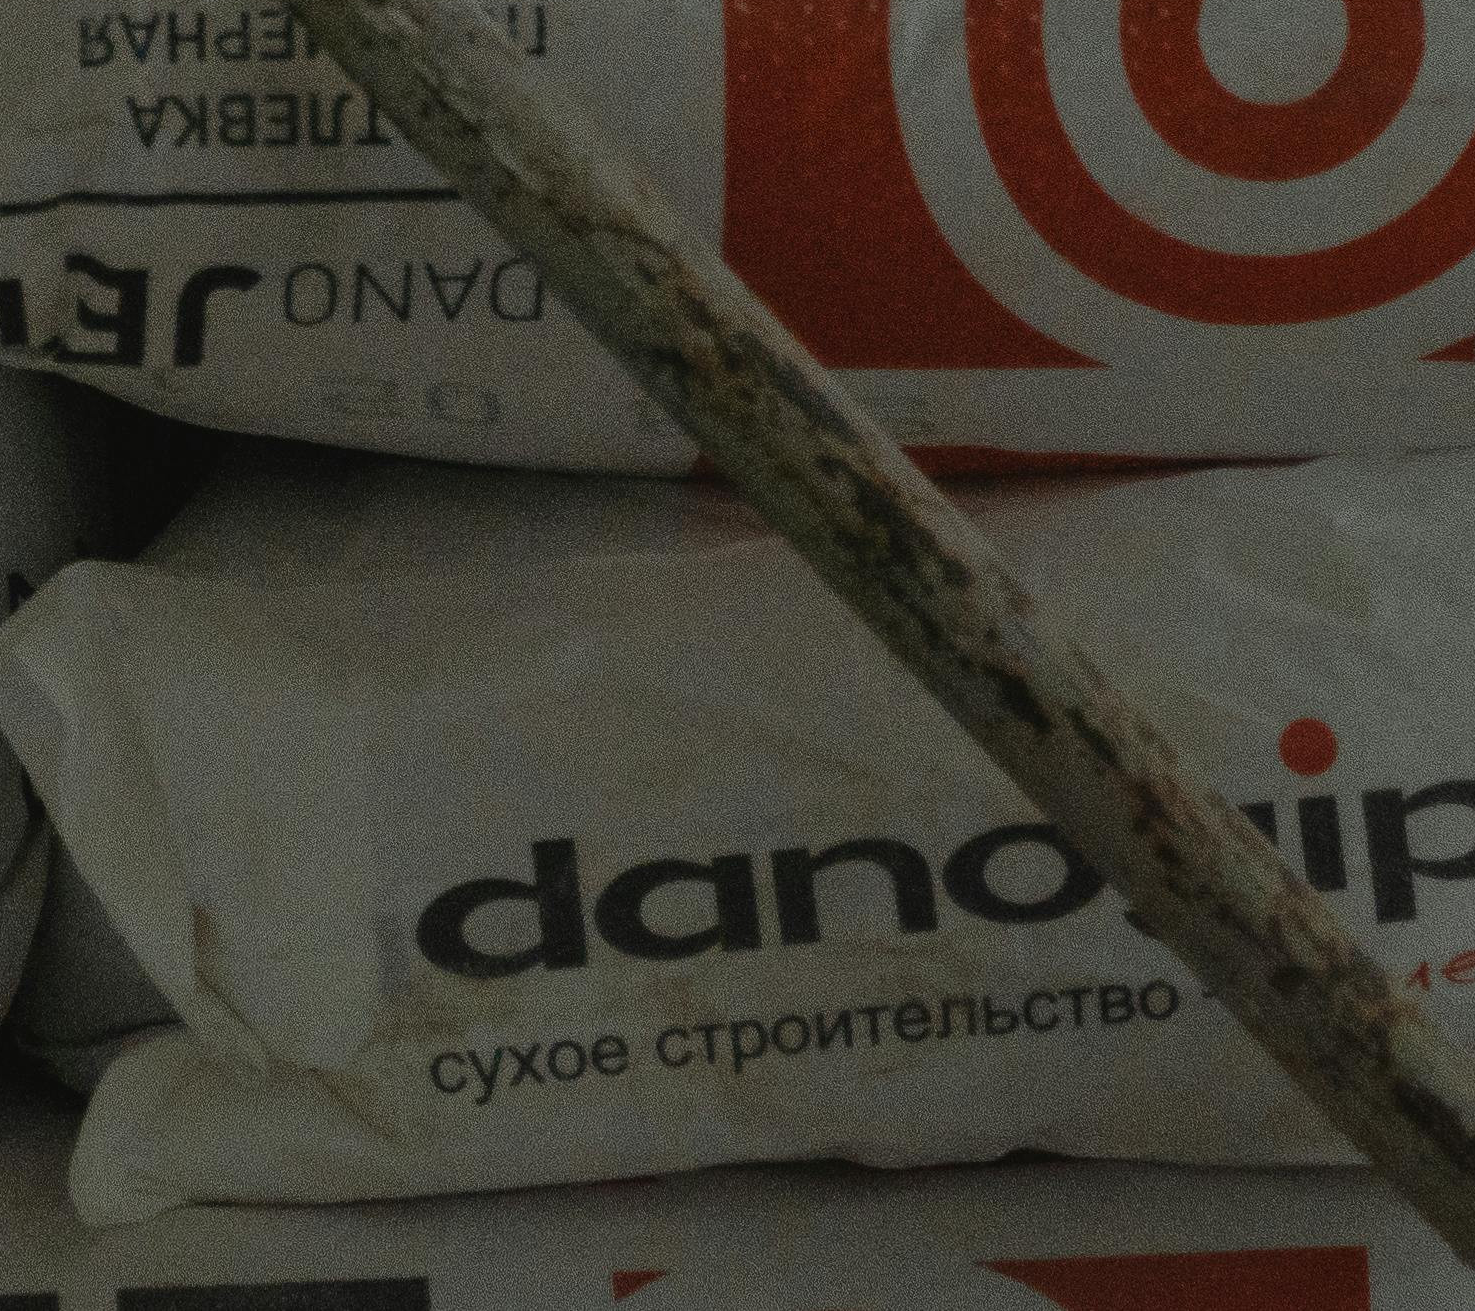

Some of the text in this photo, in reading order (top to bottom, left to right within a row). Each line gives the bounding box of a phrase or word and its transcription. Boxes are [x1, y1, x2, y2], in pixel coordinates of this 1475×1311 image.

[125, 93, 390, 147] ТЛЕВКА
[430, 1032, 629, 1106] сухое
[656, 977, 1179, 1073] строительство
